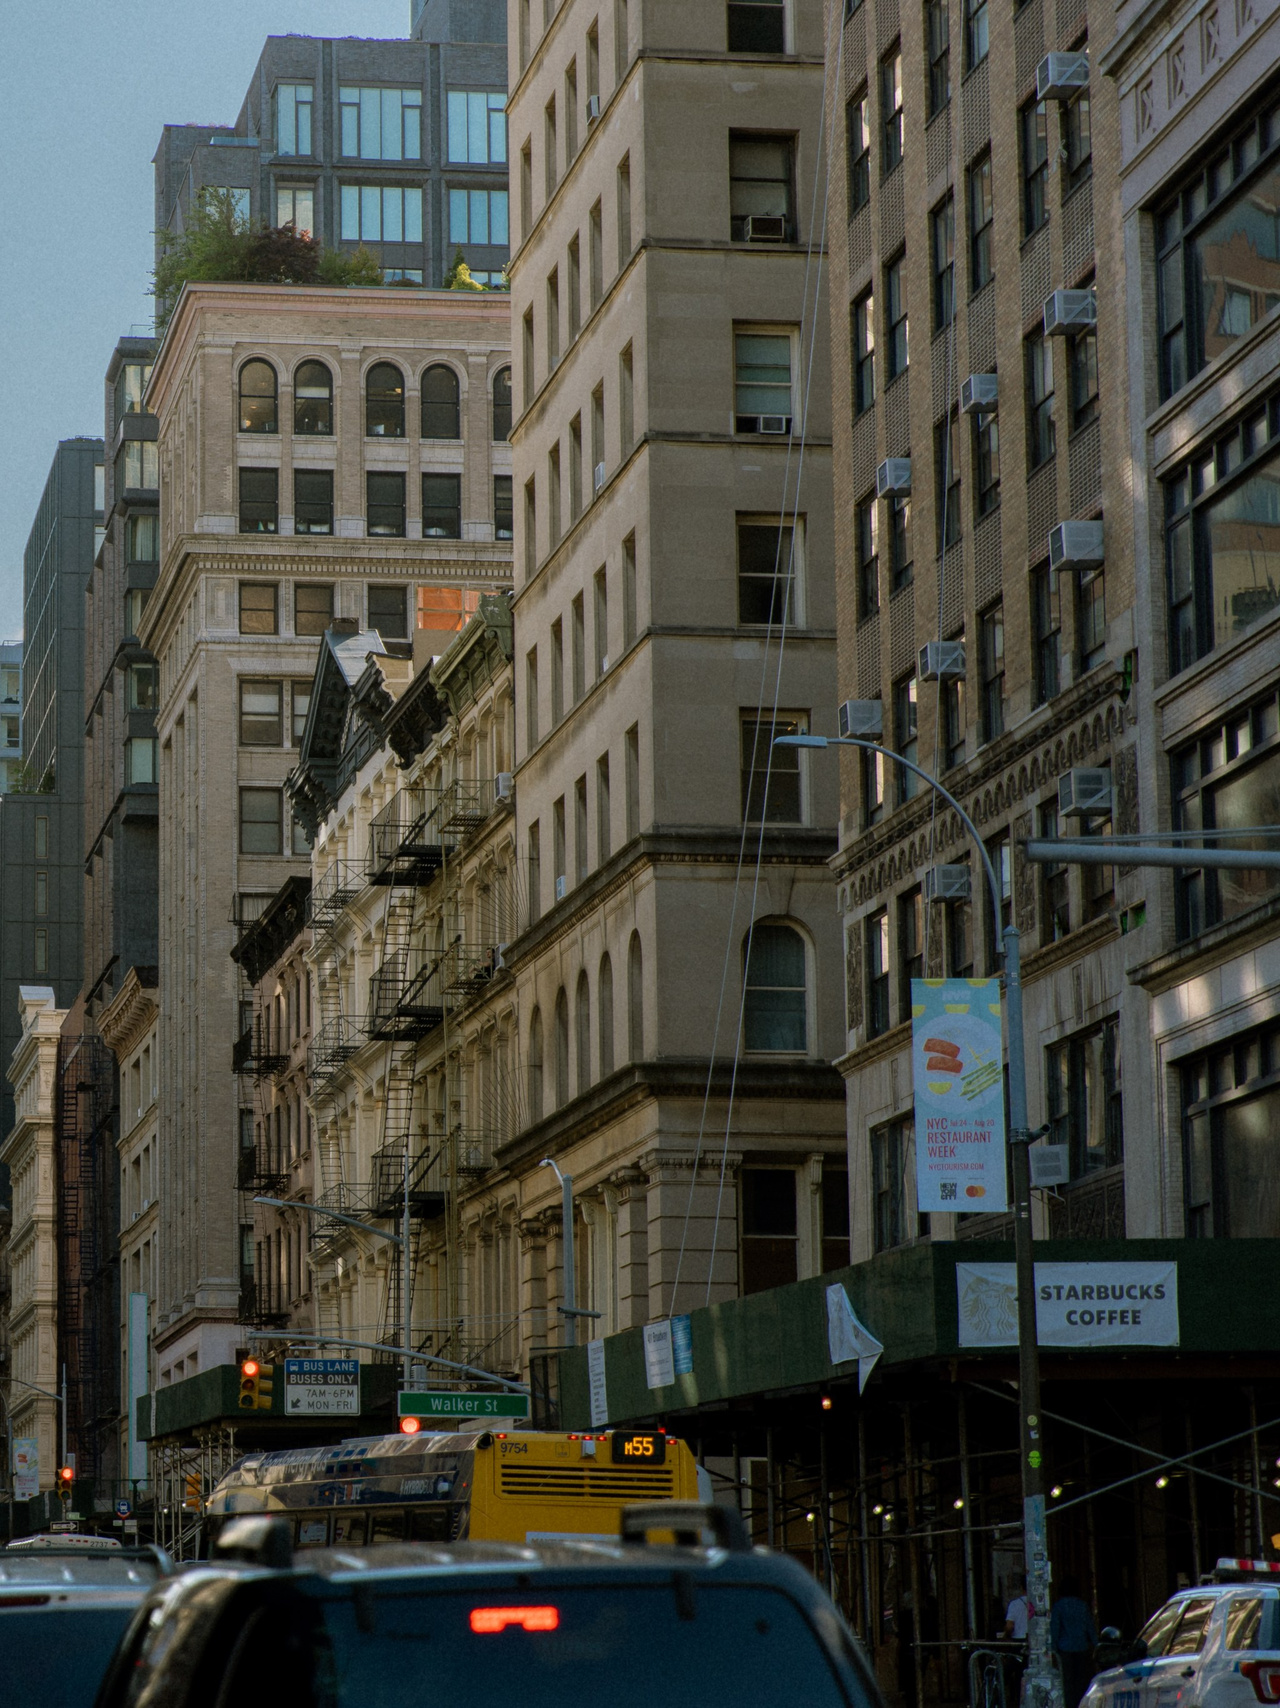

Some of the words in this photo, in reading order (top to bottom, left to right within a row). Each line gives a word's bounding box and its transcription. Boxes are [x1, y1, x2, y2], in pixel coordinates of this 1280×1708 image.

[926, 1118, 948, 1130] NYC
[974, 1120, 985, 1128] Aug
[986, 1119, 995, 1127] 20
[927, 1131, 991, 1144] RESTAURANT
[928, 1145, 956, 1158] WEEK
[928, 1163, 985, 1171] NYCTOURISM.COM
[1039, 1284, 1166, 1301] STARBUCKS
[1065, 1309, 1141, 1325] COFFEE
[303, 1361, 324, 1371] BUS
[327, 1362, 355, 1372] LANE
[290, 1374, 324, 1384] BUSES
[327, 1374, 354, 1384] ONLY
[307, 1401, 353, 1410] MON-FRI
[430, 1398, 480, 1411] Walker
[484, 1399, 498, 1412] St
[500, 1442, 529, 1454] 9754
[624, 1437, 654, 1456] M55
